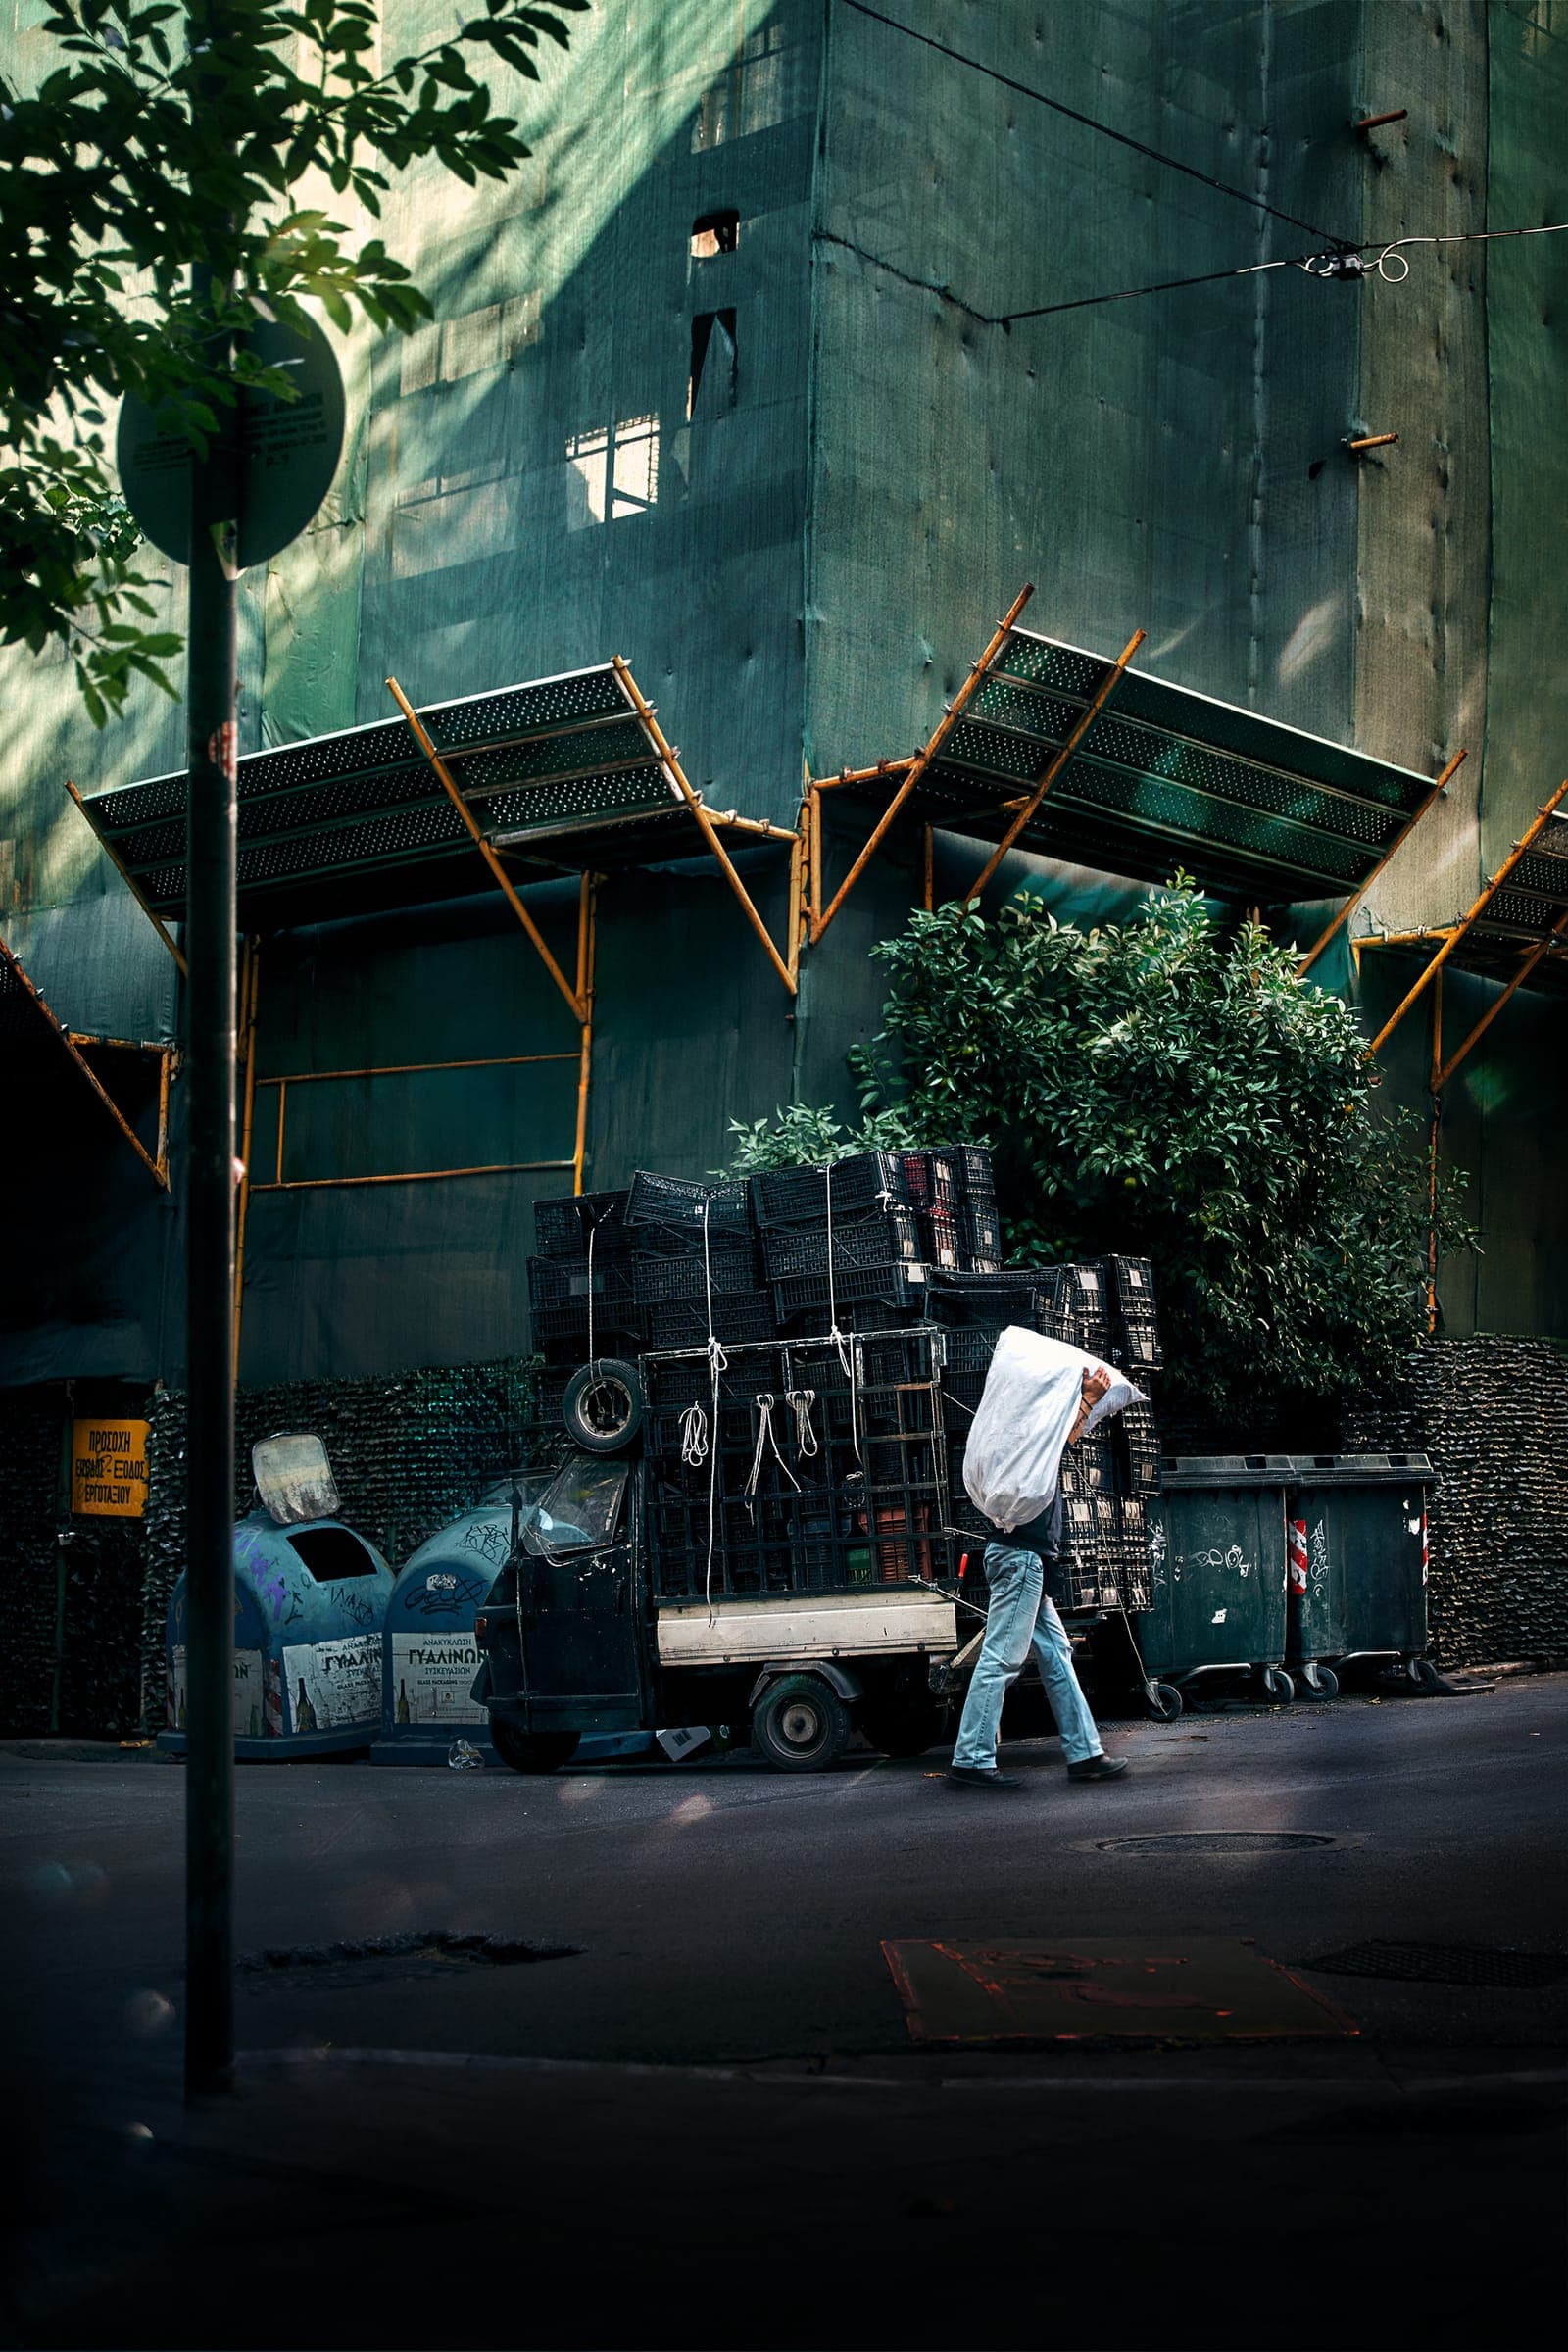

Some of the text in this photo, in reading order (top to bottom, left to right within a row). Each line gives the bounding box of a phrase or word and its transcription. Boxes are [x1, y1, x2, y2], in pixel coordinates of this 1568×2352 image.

[89, 1431, 131, 1452] ΠΡΟΣΟΧΗ
[114, 1460, 145, 1480] ΕΞΟΔΟΣ
[85, 1485, 131, 1504] ΕΡΓΟΤΑΞΙΟΥ
[423, 1638, 471, 1646] ΑΝΑΚΥΚΛΩΣΗ
